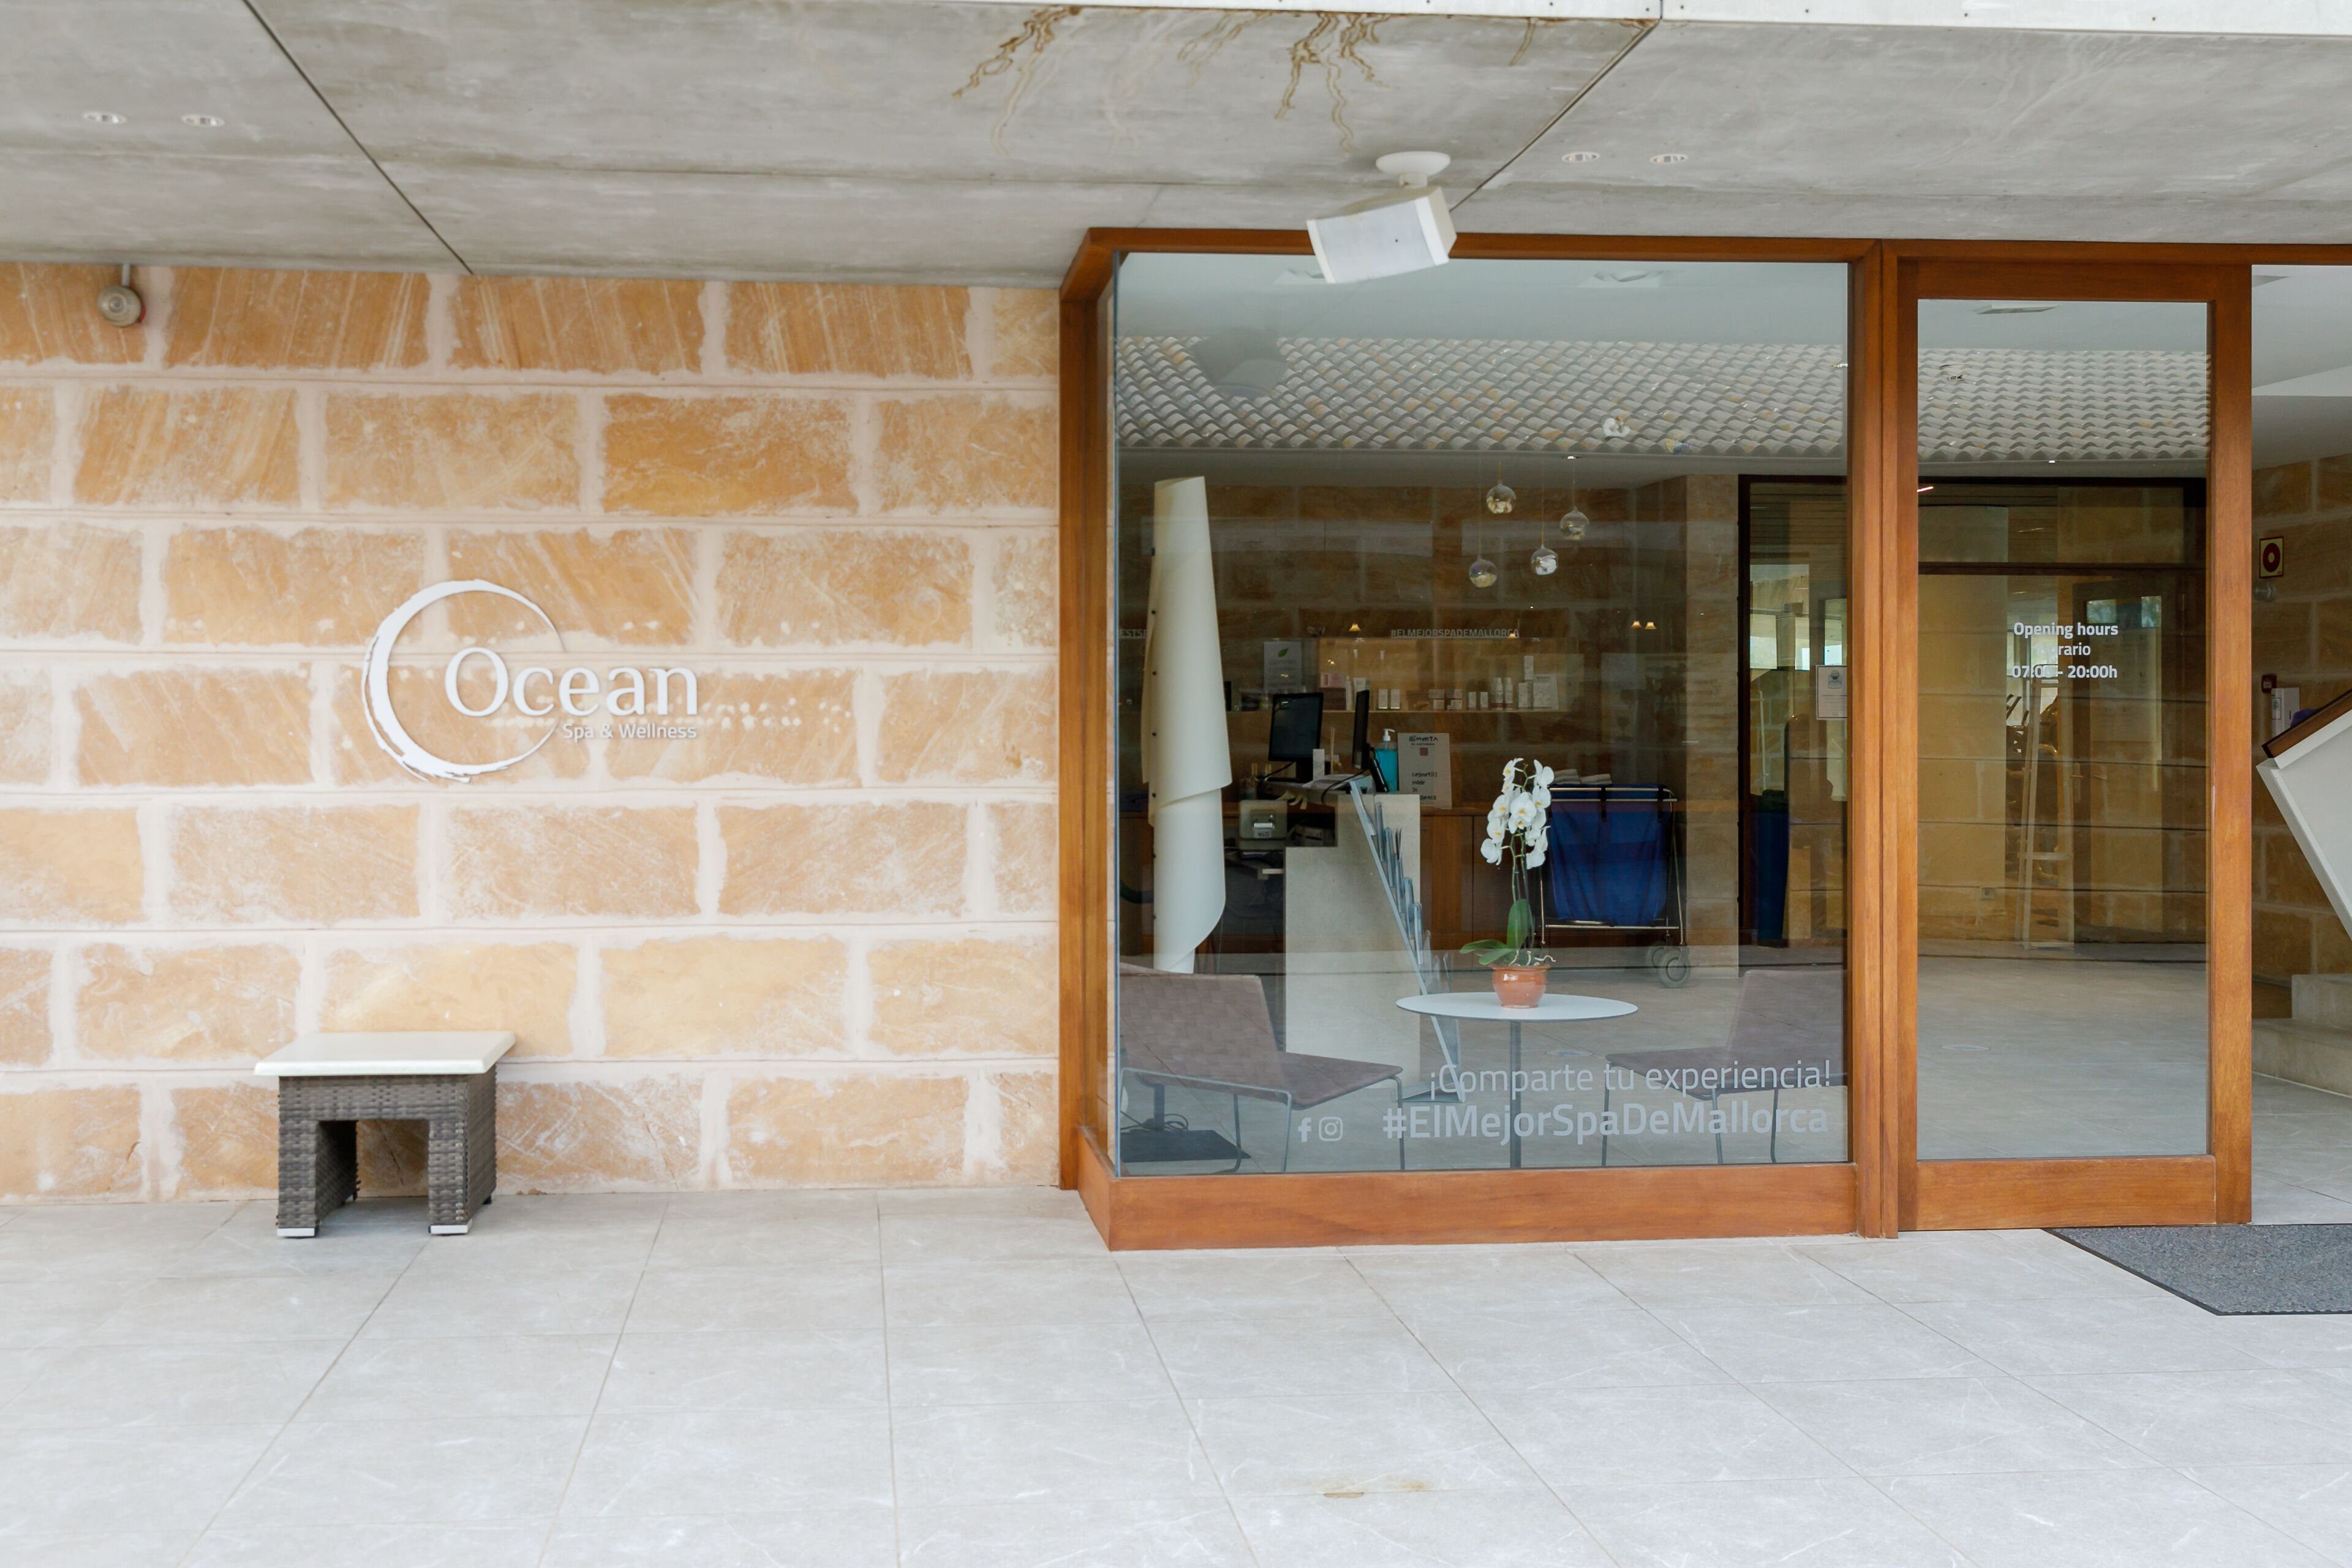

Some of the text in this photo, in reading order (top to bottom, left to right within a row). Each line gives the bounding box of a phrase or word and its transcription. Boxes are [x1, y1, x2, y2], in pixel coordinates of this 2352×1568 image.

[2013, 622, 2119, 639] Opening hours
[445, 646, 698, 717] Ocean
[2068, 665, 2117, 679] 20:00h
[563, 722, 697, 742] Spa & Wellness
[1431, 1060, 1830, 1100] ¡Comparte tu experiencia!
[1382, 1100, 1829, 1146] #ElMejorSpaDeMallorca
